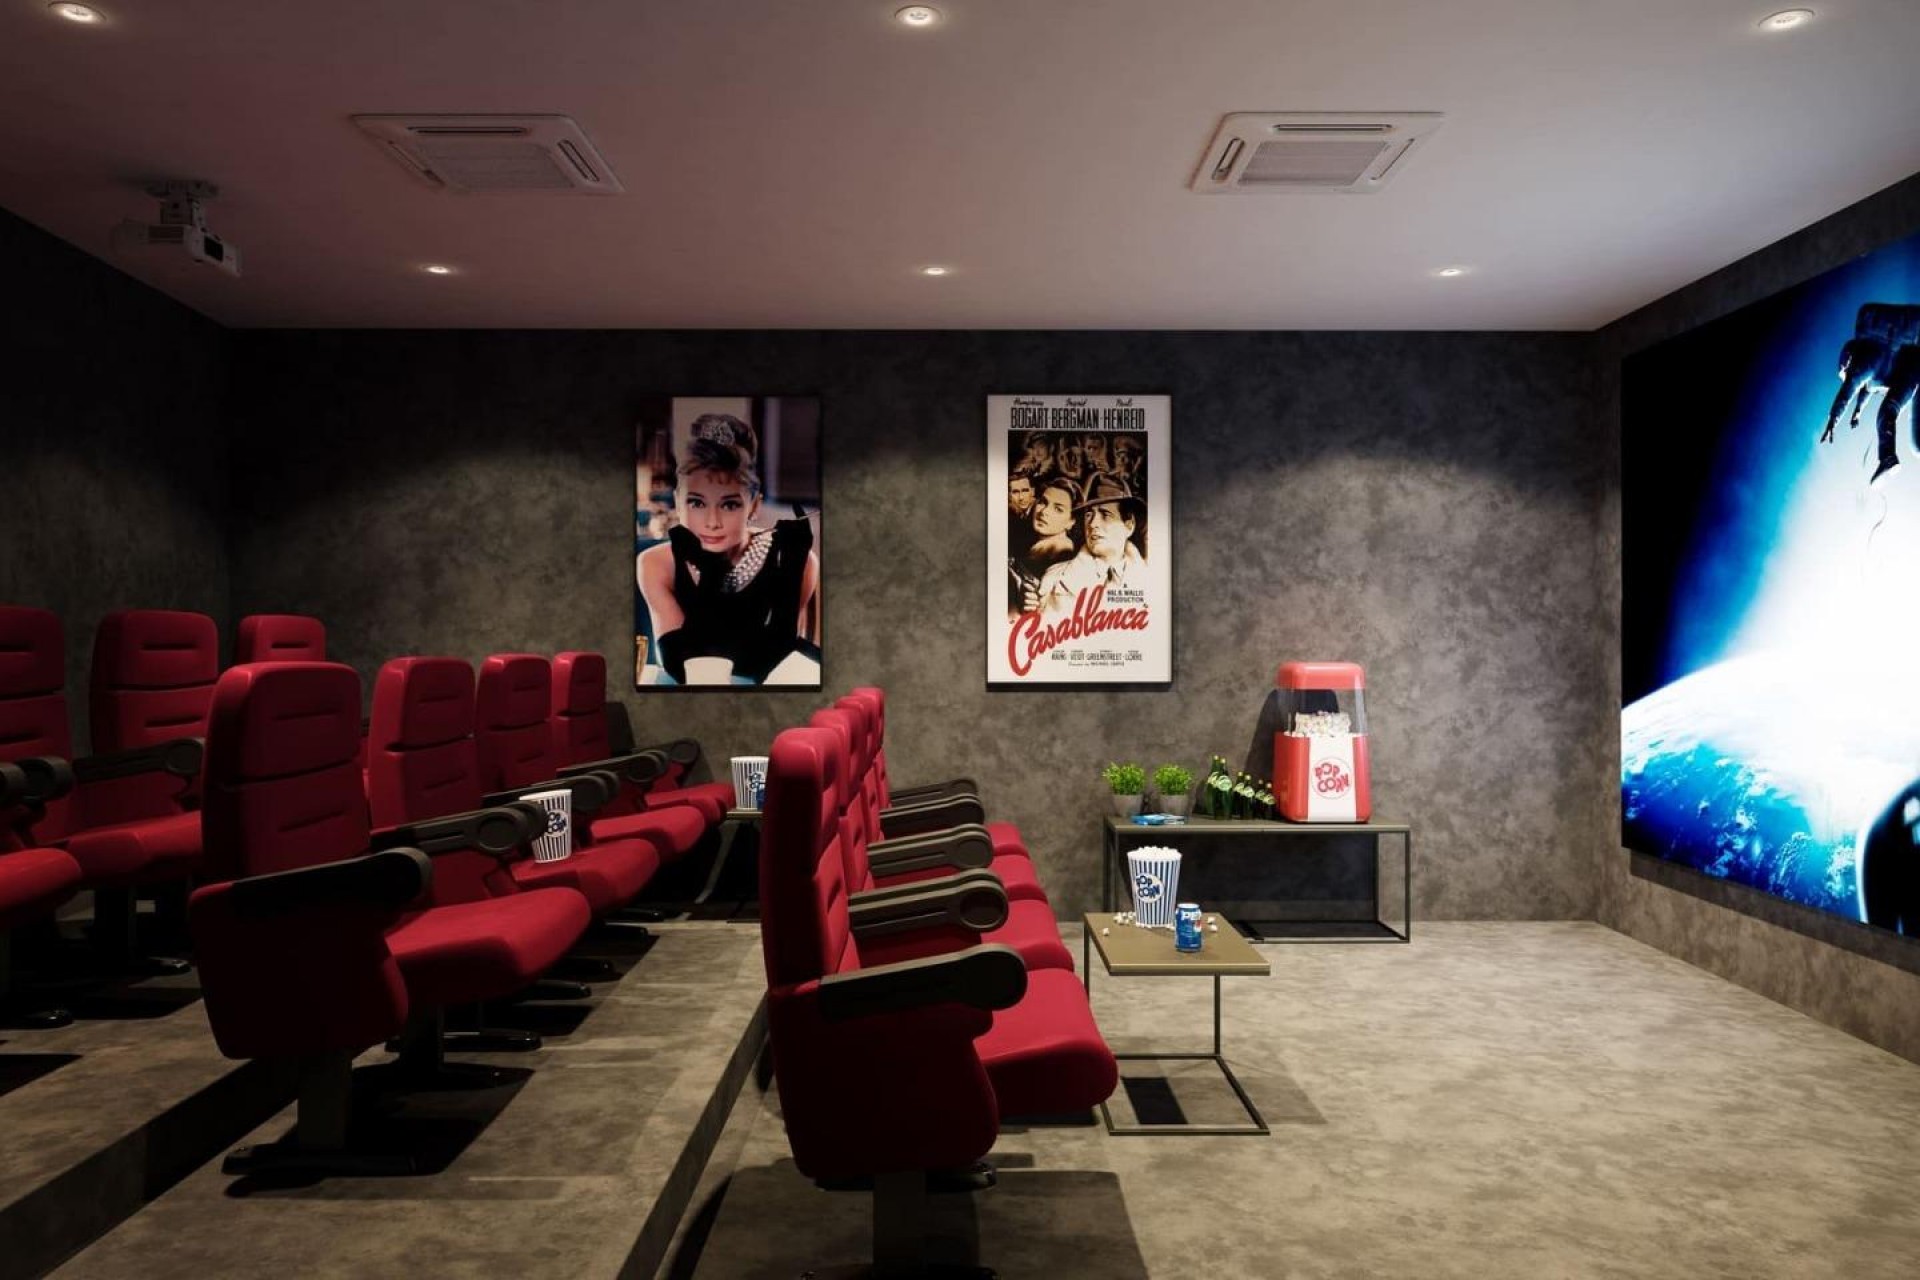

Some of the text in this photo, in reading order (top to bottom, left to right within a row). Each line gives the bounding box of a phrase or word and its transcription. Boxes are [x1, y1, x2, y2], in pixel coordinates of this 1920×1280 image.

[1010, 408, 1145, 429] BOGART BERGMAN HENREID
[1008, 584, 1149, 676] Casablanca
[1314, 762, 1340, 780] POP
[1317, 773, 1350, 793] CORN
[1135, 875, 1153, 887] POP
[1138, 884, 1161, 898] CORN
